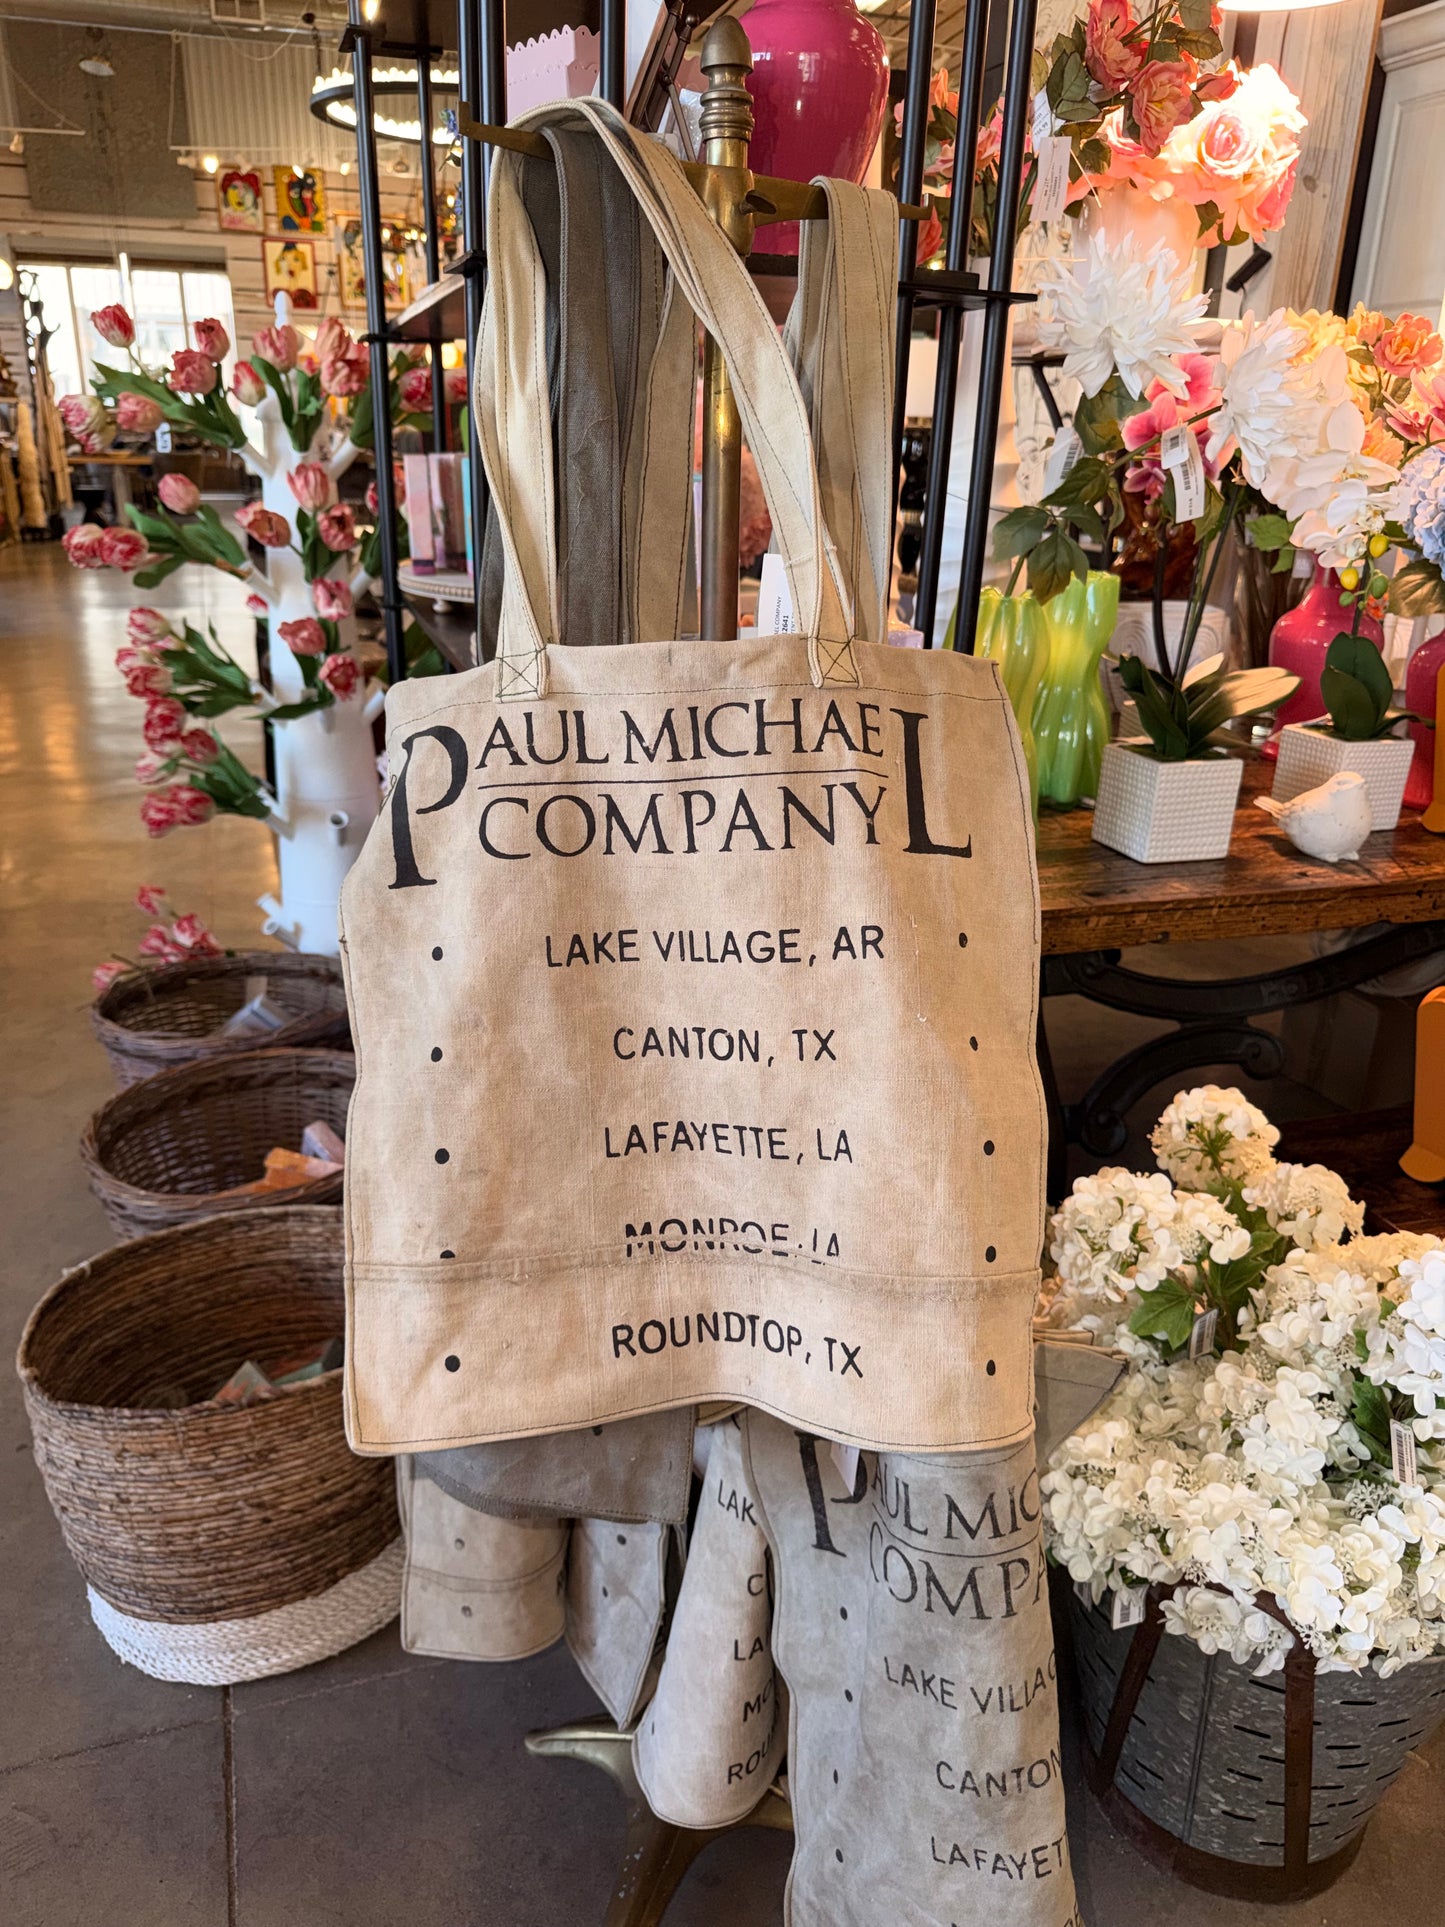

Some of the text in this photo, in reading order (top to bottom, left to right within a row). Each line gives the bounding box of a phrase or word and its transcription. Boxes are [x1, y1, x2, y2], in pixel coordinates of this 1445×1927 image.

[774, 595, 782, 625] COMPANY
[781, 615, 789, 634] 2641
[477, 782, 887, 860] COMPANY
[545, 924, 885, 968] LAKE VILLAGE, AR
[612, 1026, 837, 1067] CANTON, TX
[604, 1120, 853, 1165] LAFAYETTE, LA
[611, 1311, 864, 1378] ROUNDTOP, TX
[718, 1478, 757, 1527] LAK
[943, 1466, 1041, 1542] MIC
[869, 1521, 1047, 1620] COMPA
[884, 1656, 958, 1710] LAKE
